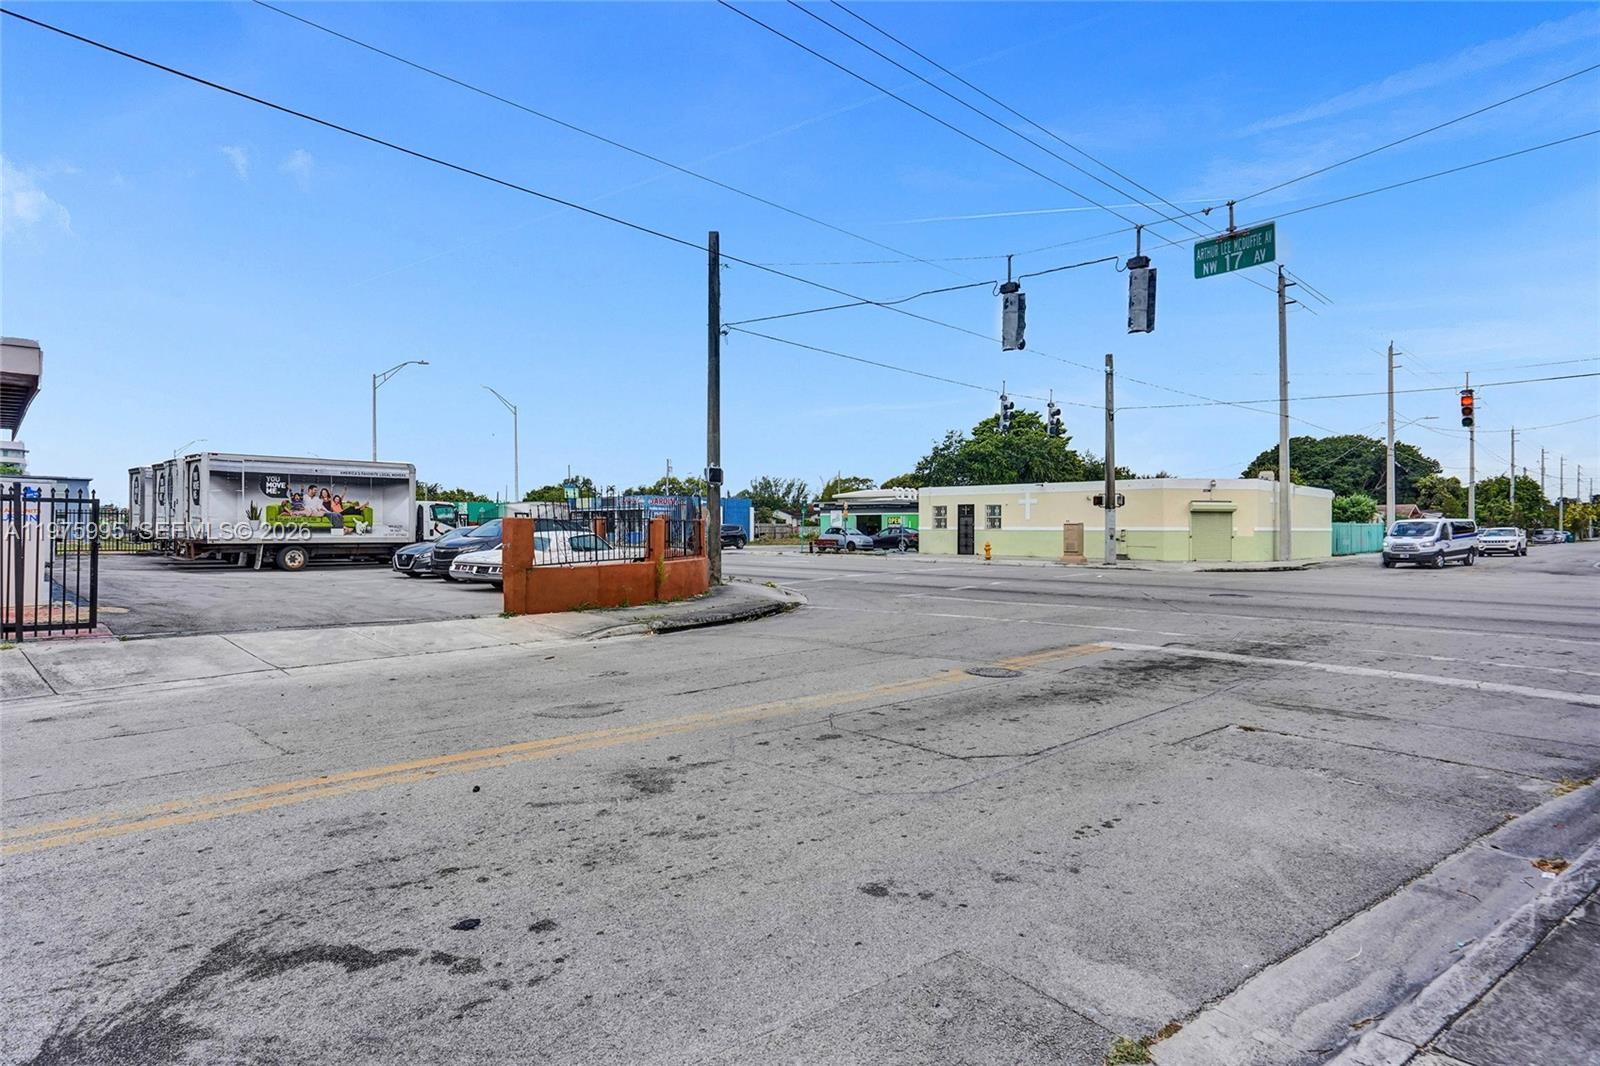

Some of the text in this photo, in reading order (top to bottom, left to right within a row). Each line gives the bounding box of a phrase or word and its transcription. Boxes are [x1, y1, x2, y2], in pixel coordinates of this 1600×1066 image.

[1196, 231, 1273, 261] ARTHUR LEE MCDUFFIE AV
[1203, 248, 1266, 275] NW 17 AV
[265, 475, 281, 483] YOU
[887, 517, 902, 525] OPEN
